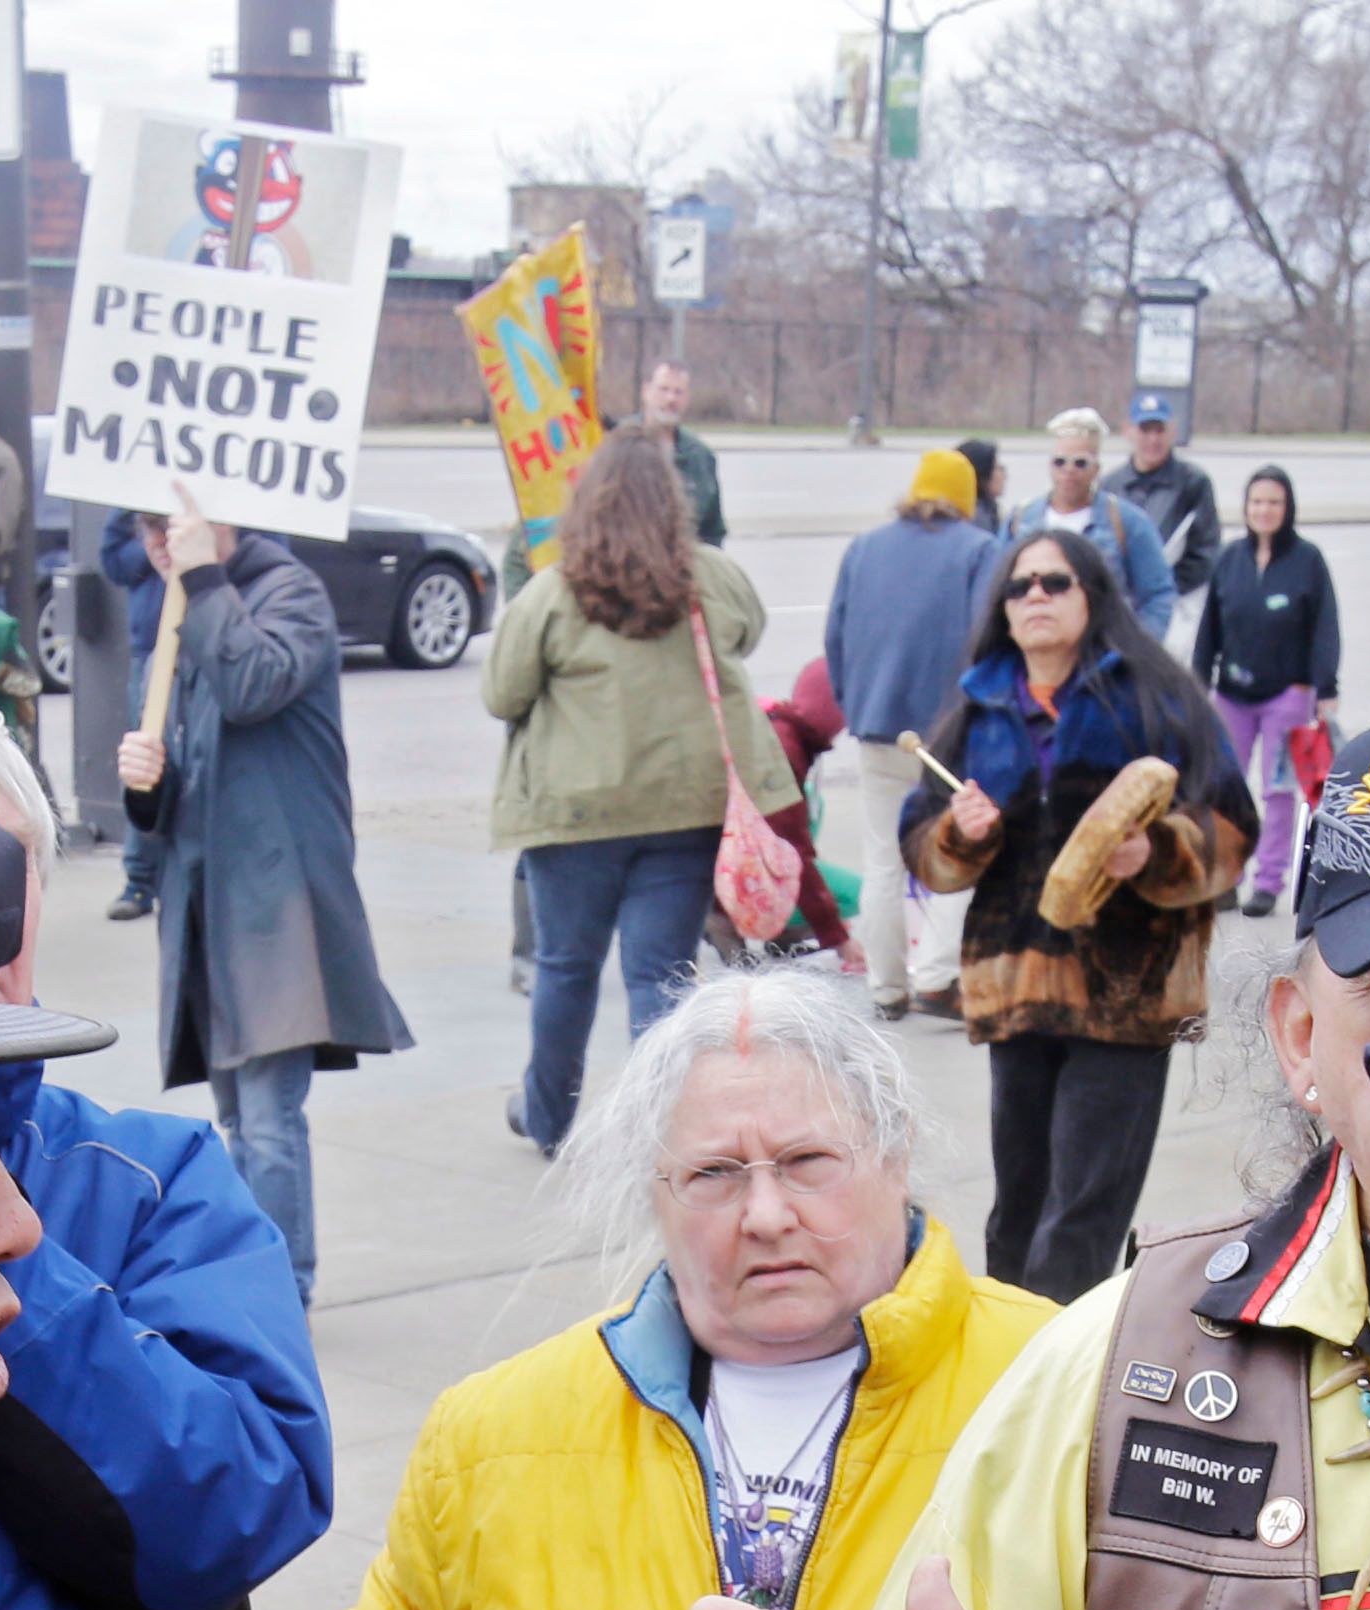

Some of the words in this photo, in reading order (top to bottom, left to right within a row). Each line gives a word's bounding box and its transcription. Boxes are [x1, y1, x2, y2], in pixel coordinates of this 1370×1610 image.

[92, 284, 319, 362] PEOPLE
[148, 354, 308, 421] NOT
[63, 405, 346, 502] MASCOTS
[1131, 1443, 1151, 1462] IN
[1154, 1447, 1234, 1481] MEMORY
[1238, 1467, 1263, 1484] OF
[1162, 1477, 1192, 1500] Bill
[1196, 1485, 1216, 1506] W.
